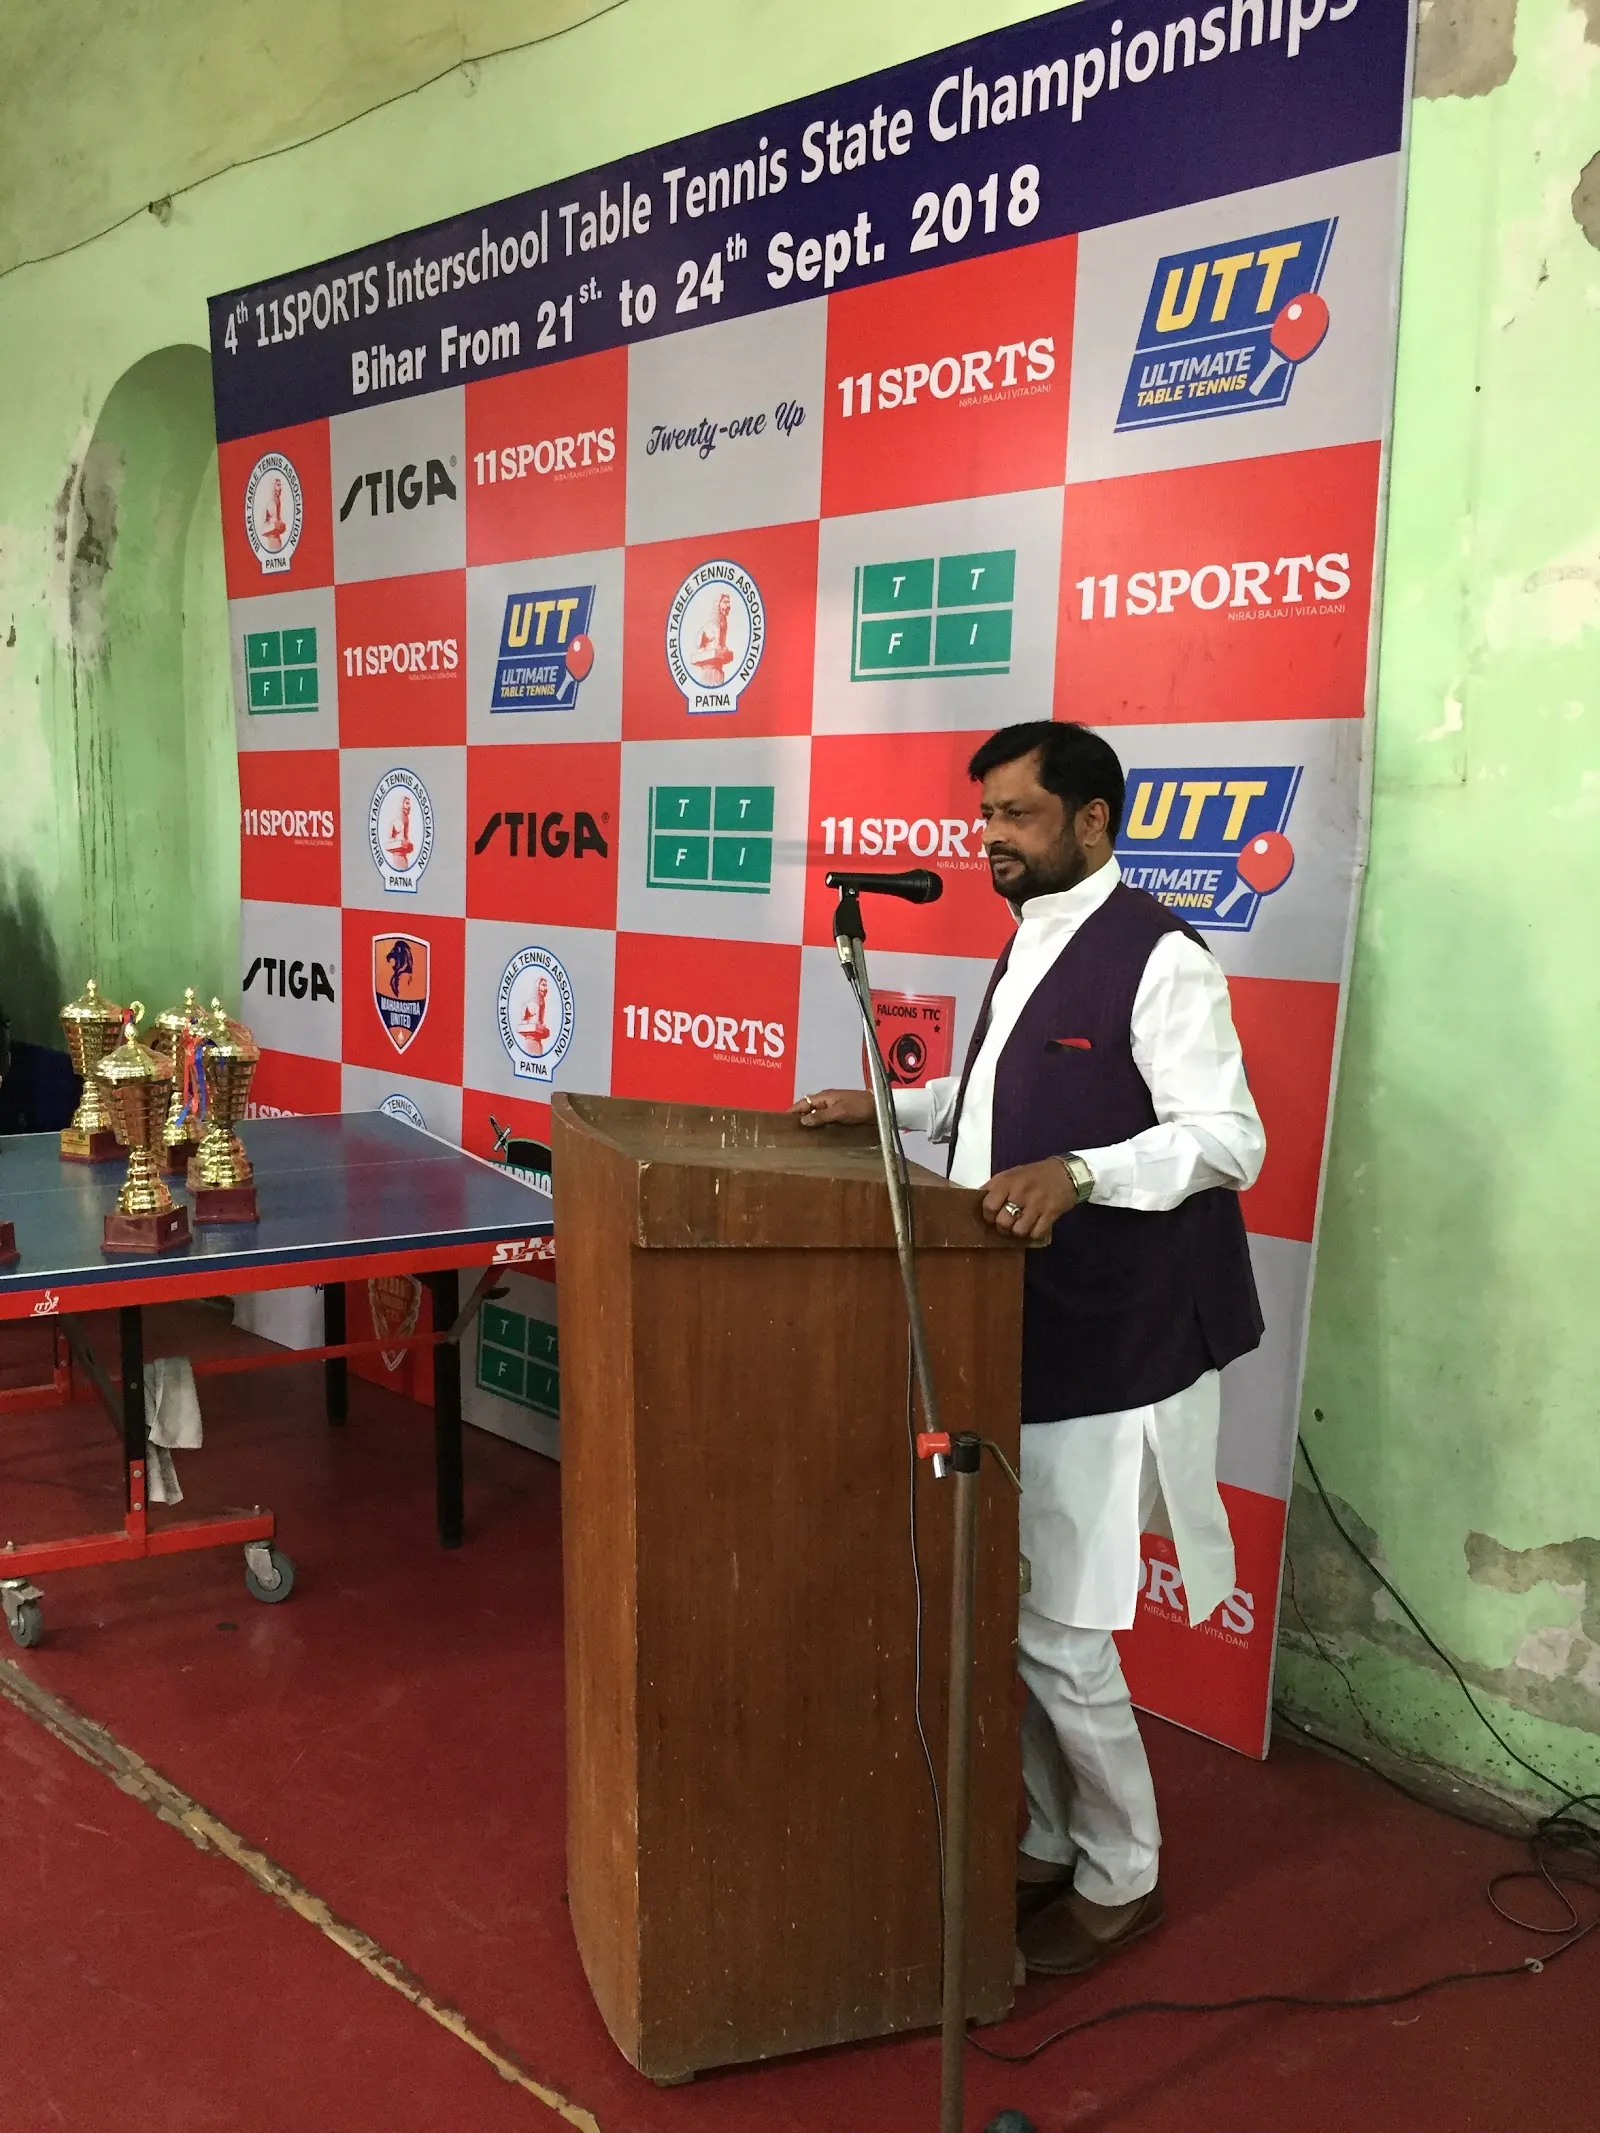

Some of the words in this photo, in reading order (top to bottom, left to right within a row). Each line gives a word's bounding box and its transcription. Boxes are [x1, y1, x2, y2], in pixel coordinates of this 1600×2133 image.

[224, 300, 249, 356] 4th
[256, 265, 379, 348] 11SPORTS
[386, 209, 548, 309] Interschool
[559, 181, 652, 257] Table
[663, 136, 788, 225] Tennis
[801, 104, 913, 184] State
[352, 344, 426, 396] Bihar
[441, 320, 520, 374] From
[619, 279, 657, 328] to
[675, 233, 748, 314] 24th
[767, 211, 886, 290] Sept.
[910, 163, 1041, 254] 2018
[1156, 241, 1302, 333] UTT
[838, 337, 1056, 418] 11SPORTS
[1140, 346, 1256, 389] ULTIMATE
[1137, 385, 1186, 407] TABLE
[1188, 373, 1248, 398] TENNIS
[646, 413, 767, 460] Twenty-one
[775, 400, 806, 437] Up
[257, 457, 283, 473] TENNIS
[473, 427, 616, 485] 11SPORTS
[265, 557, 287, 569] PATNA
[693, 565, 735, 586] TENNIS
[892, 576, 906, 598] T
[970, 568, 985, 590] T
[1076, 552, 1350, 620] 11SPORTS
[670, 583, 694, 632] TABLE
[1228, 611, 1256, 621] NIRAJ
[1258, 608, 1288, 619] BAJAJ
[1295, 605, 1317, 616] VITA
[1320, 604, 1345, 615] DANI
[508, 598, 579, 648] UTT
[735, 575, 762, 682] ASSOCIATION
[261, 642, 268, 658] T
[296, 639, 303, 655] T
[344, 638, 459, 677] 11SPORTS
[888, 632, 903, 654] F
[501, 665, 559, 685] ULTIMATE
[669, 638, 688, 686] BIHAR
[263, 681, 270, 697] F
[500, 685, 524, 697] TABLE
[525, 684, 556, 697] TENNIS
[695, 694, 730, 707] PATNA
[385, 773, 413, 788] TENNIS
[244, 808, 335, 838] 11SPORTS
[678, 799, 689, 818] T
[739, 799, 750, 819] T
[1126, 781, 1268, 840] UTT
[676, 848, 687, 866] F
[936, 860, 958, 870] NIRAJ
[960, 861, 983, 871] BAJAJ
[389, 876, 413, 888] PATNA
[518, 951, 552, 968] TENNIS
[500, 961, 519, 1002] TABLE
[390, 1012, 412, 1029] UNITED
[551, 965, 572, 1057] ASSOCIATION
[877, 1003, 917, 1019] FALCONS
[922, 1008, 940, 1021] TTC
[500, 1007, 514, 1050] BIHAR
[623, 1004, 785, 1058] 11SPORTS
[520, 1061, 548, 1076] PATNA
[387, 1099, 413, 1115] TENNIS
[1144, 1602, 1170, 1620] NIRAJ
[1205, 1625, 1225, 1641] VITA
[1226, 1633, 1249, 1650] DANI
